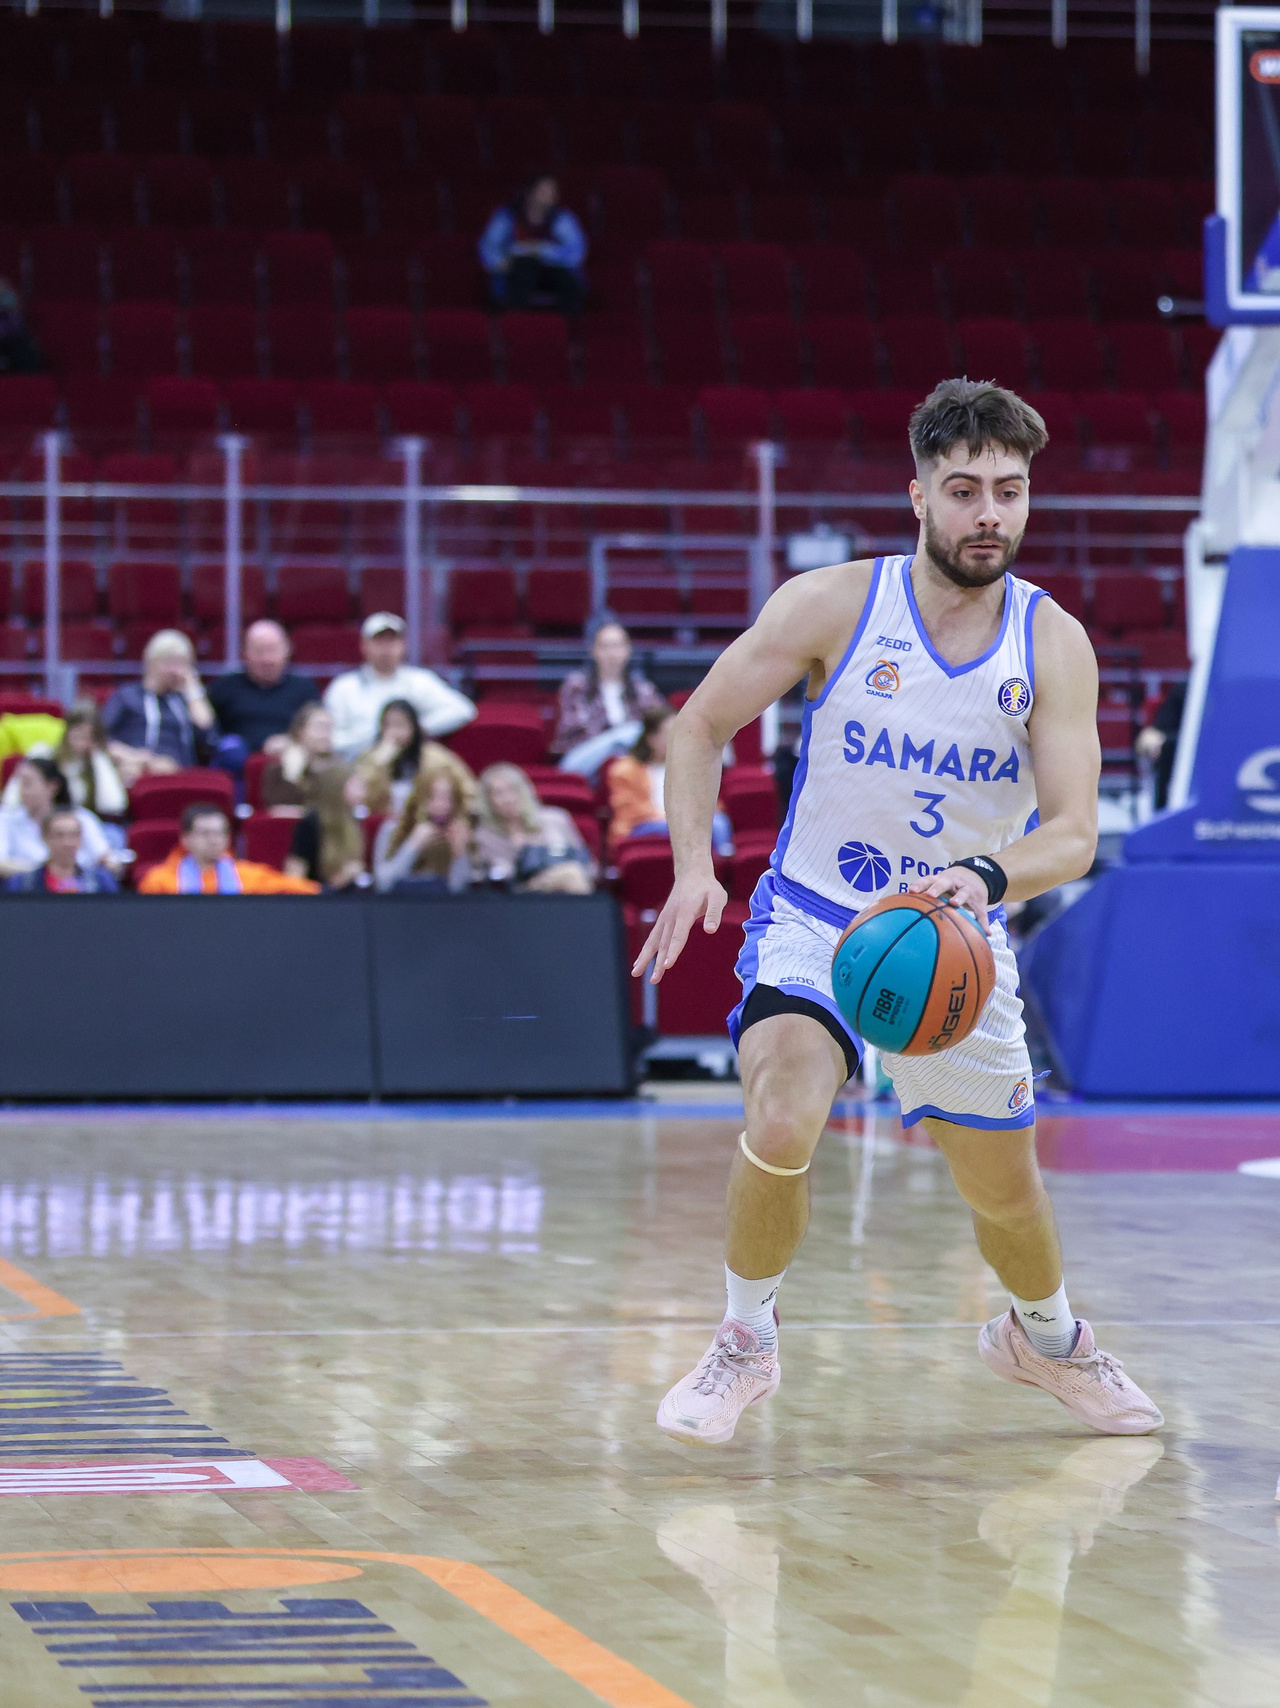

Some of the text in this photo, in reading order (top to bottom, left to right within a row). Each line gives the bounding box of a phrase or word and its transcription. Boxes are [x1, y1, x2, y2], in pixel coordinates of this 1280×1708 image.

[876, 635, 913, 652] ZEDO
[843, 720, 1020, 783] SAMARA
[909, 790, 947, 838] 3
[872, 988, 897, 1022] FIBA
